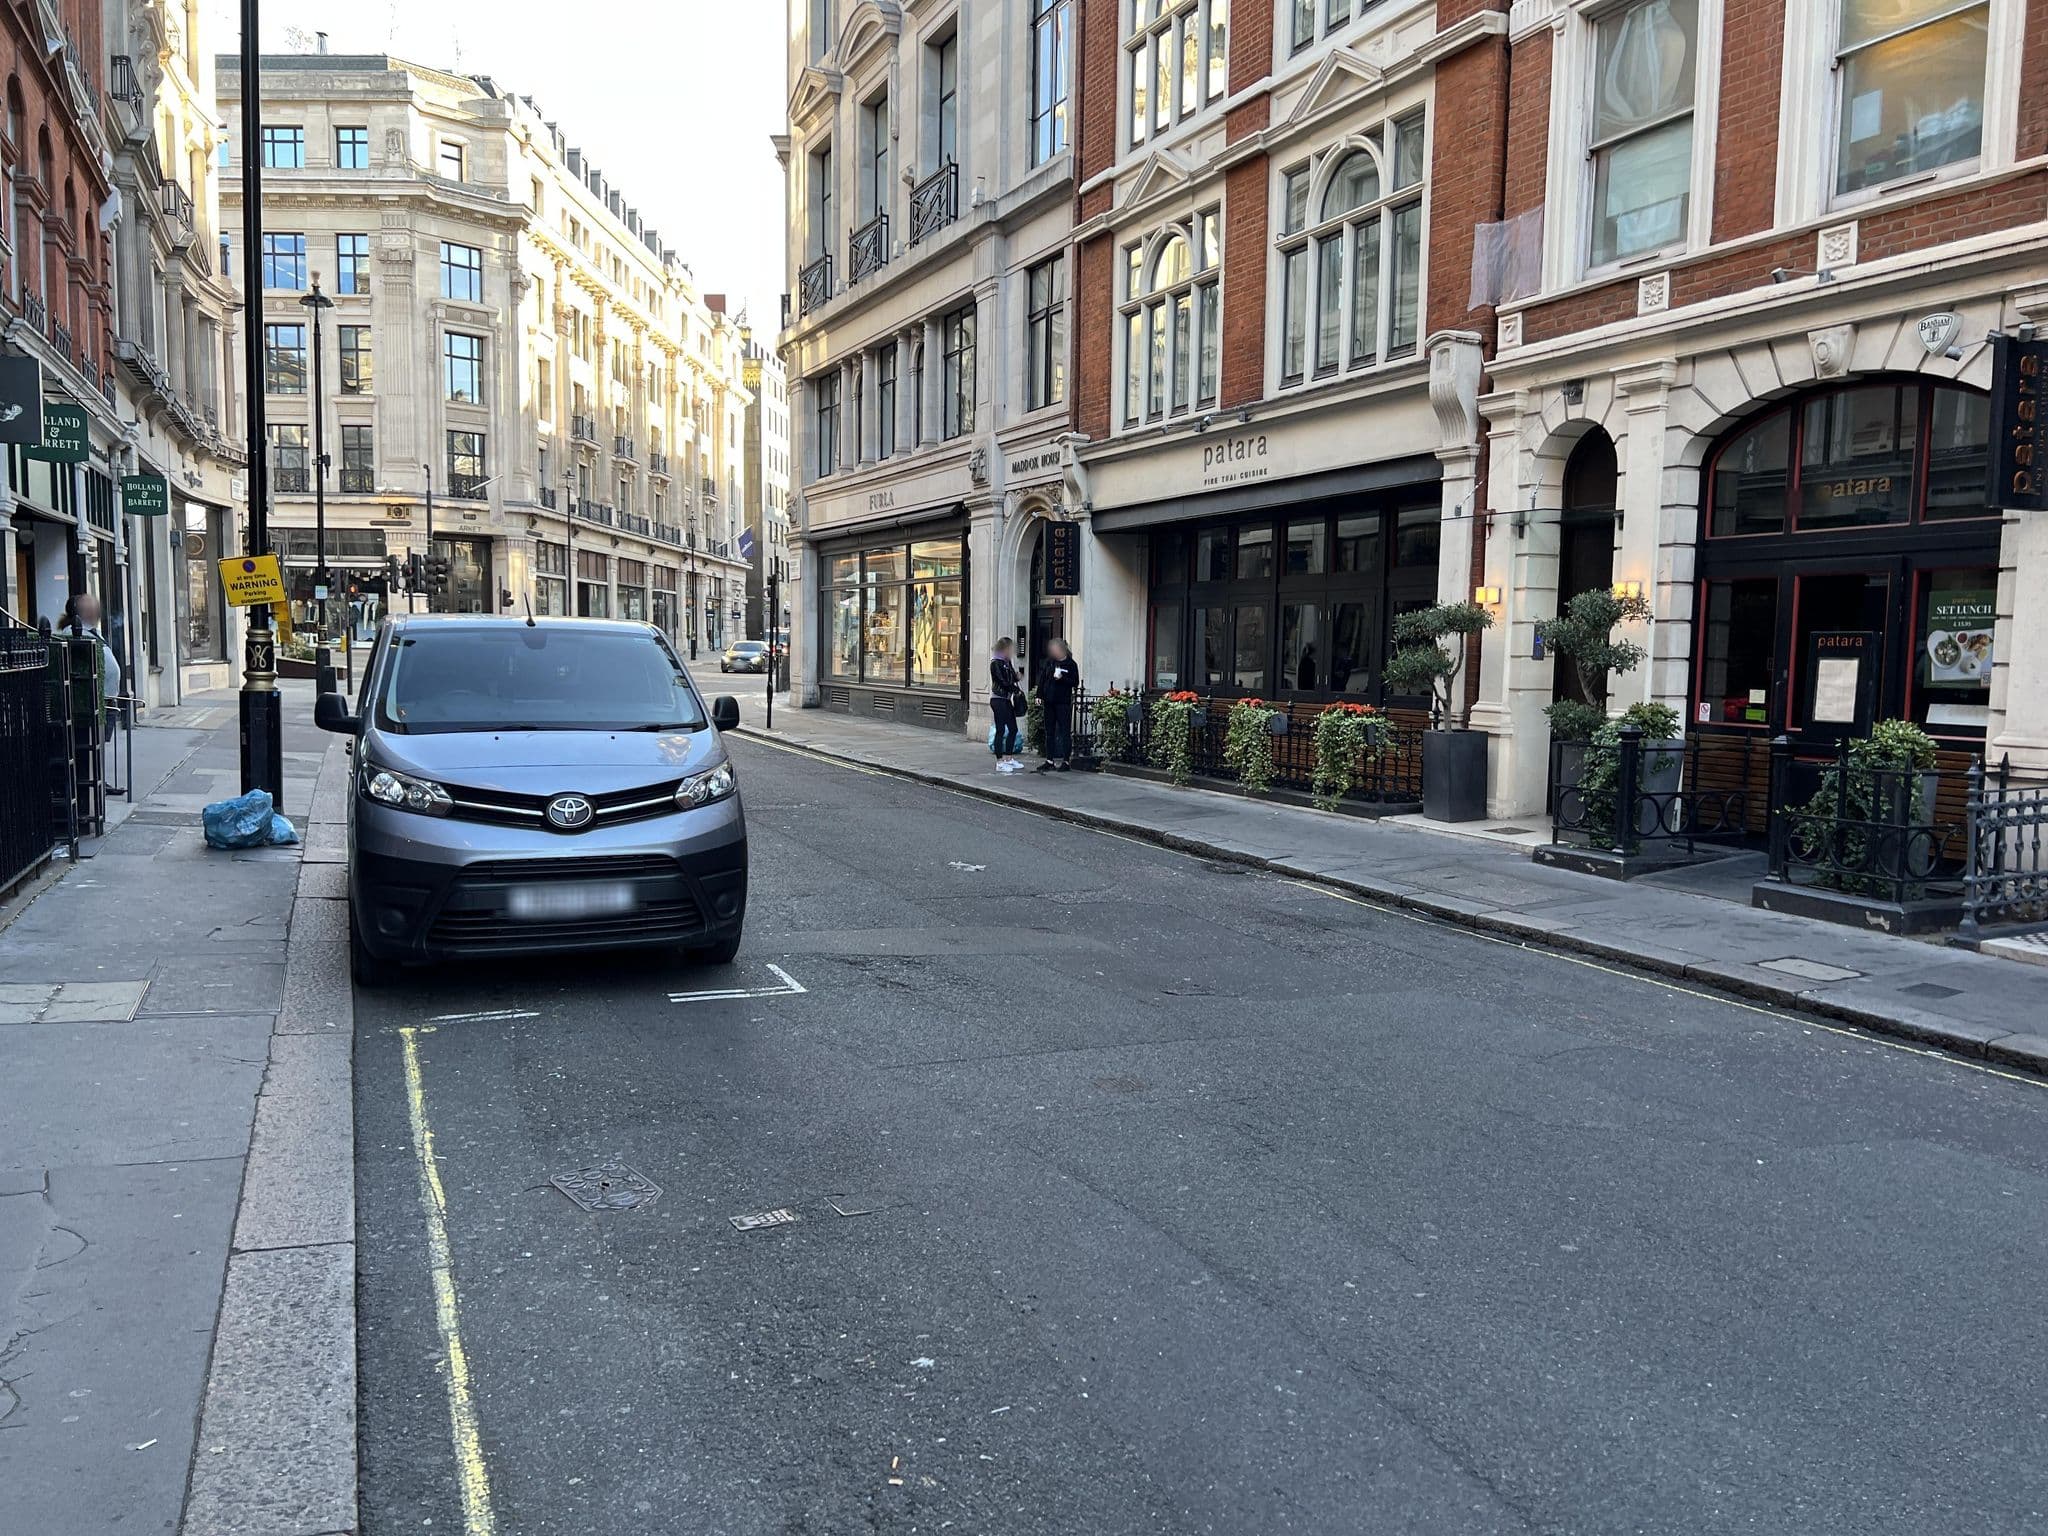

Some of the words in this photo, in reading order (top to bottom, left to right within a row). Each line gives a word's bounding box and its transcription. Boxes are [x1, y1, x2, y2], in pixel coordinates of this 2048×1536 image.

[1920, 318, 1950, 331] BANHAM
[44, 415, 81, 428] LLAND
[2012, 355, 2041, 495] patara
[49, 426, 60, 438] &
[1204, 435, 1267, 472] patara
[1011, 456, 1039, 473] MADDOX
[1221, 474, 1237, 483] THAI
[1240, 468, 1267, 479] CUISINE
[127, 482, 162, 493] HOLLAND
[141, 490, 148, 499] &
[869, 490, 895, 510] FURLA
[128, 498, 162, 507] BARRETT
[458, 525, 481, 533] ARKET
[1051, 527, 1068, 589] patara
[229, 578, 278, 591] WARNING
[1936, 605, 1956, 615] SET
[1956, 604, 1992, 615] LUNCH
[1817, 635, 1863, 649] patara
